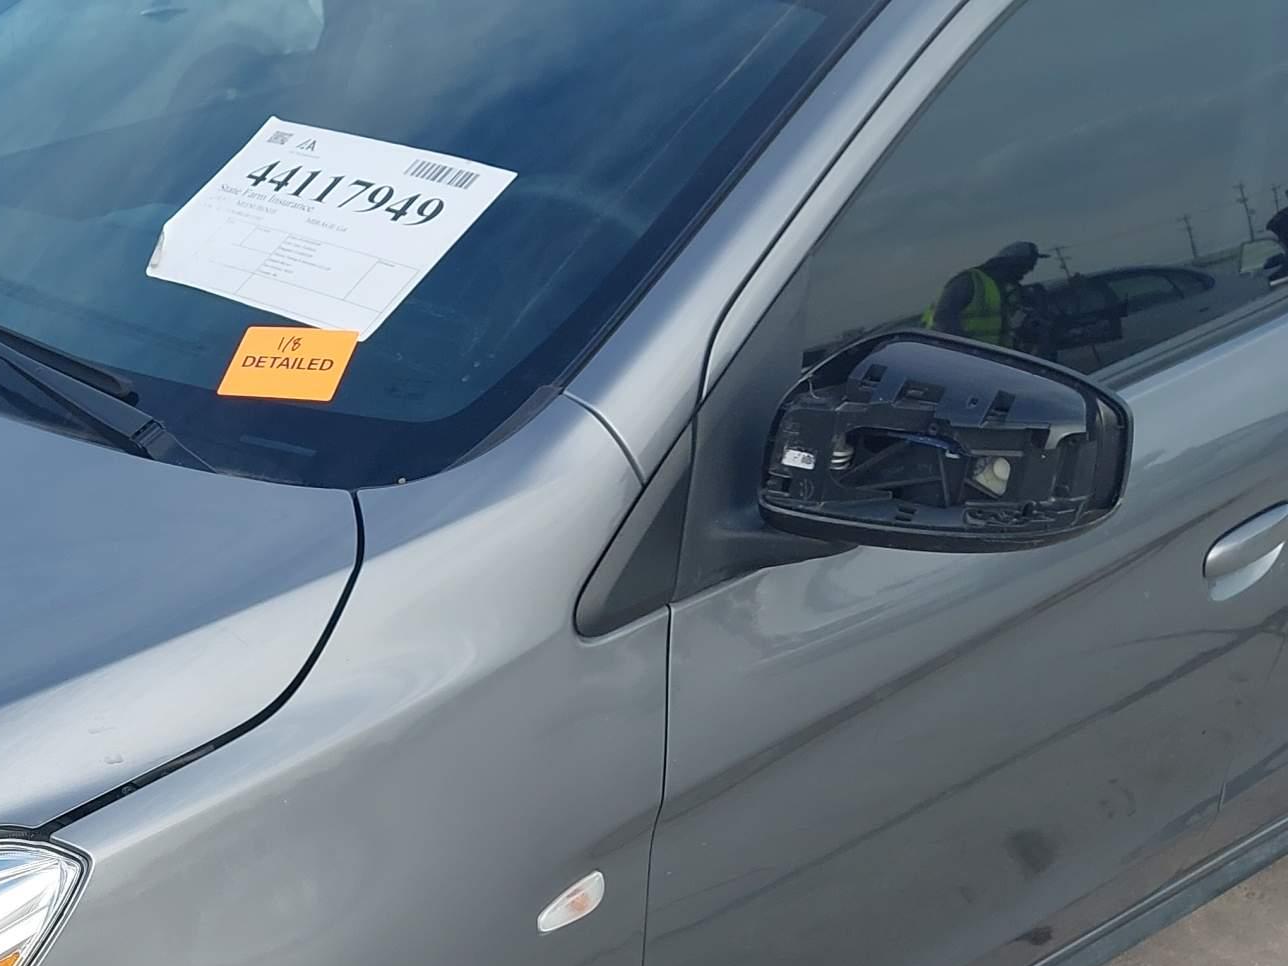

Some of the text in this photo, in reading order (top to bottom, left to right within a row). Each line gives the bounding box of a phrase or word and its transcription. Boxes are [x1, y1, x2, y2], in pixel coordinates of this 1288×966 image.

[241, 188, 268, 201] Farm
[267, 194, 315, 213] Insurance
[246, 160, 445, 226] 44117949
[276, 336, 304, 353] 1/8
[241, 355, 335, 372] DETAILED
